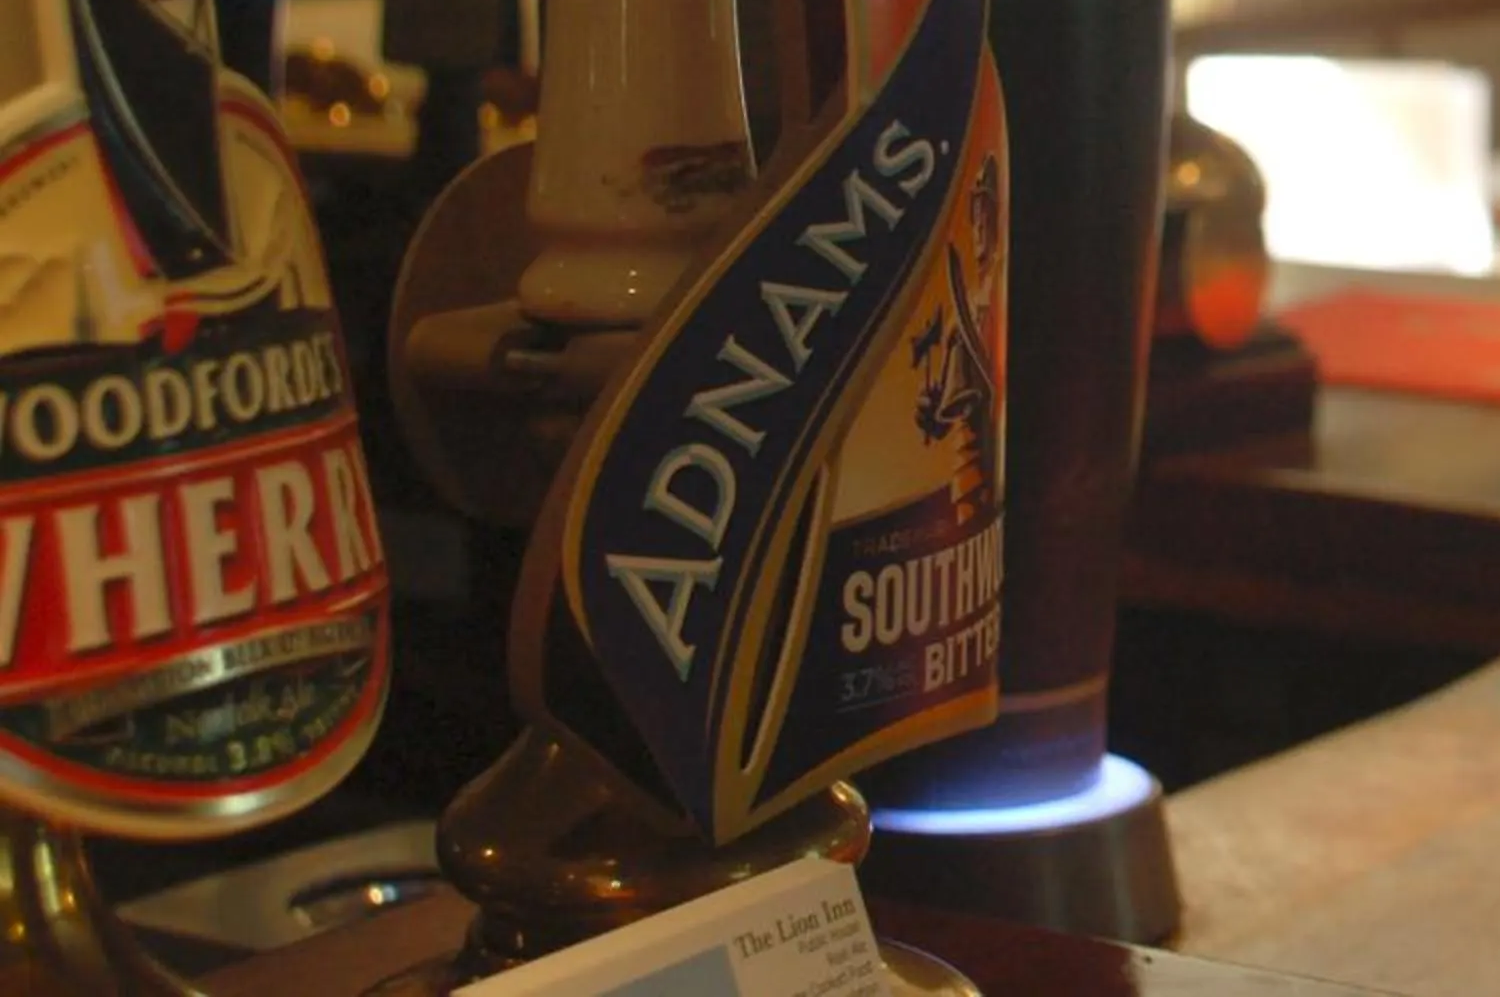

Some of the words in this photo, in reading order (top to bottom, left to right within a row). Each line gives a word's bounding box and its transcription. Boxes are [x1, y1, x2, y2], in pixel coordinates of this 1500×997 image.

[0, 447, 382, 667] HERR
[734, 930, 774, 958] The
[776, 914, 820, 943] Lion
[822, 899, 856, 923] Inn
